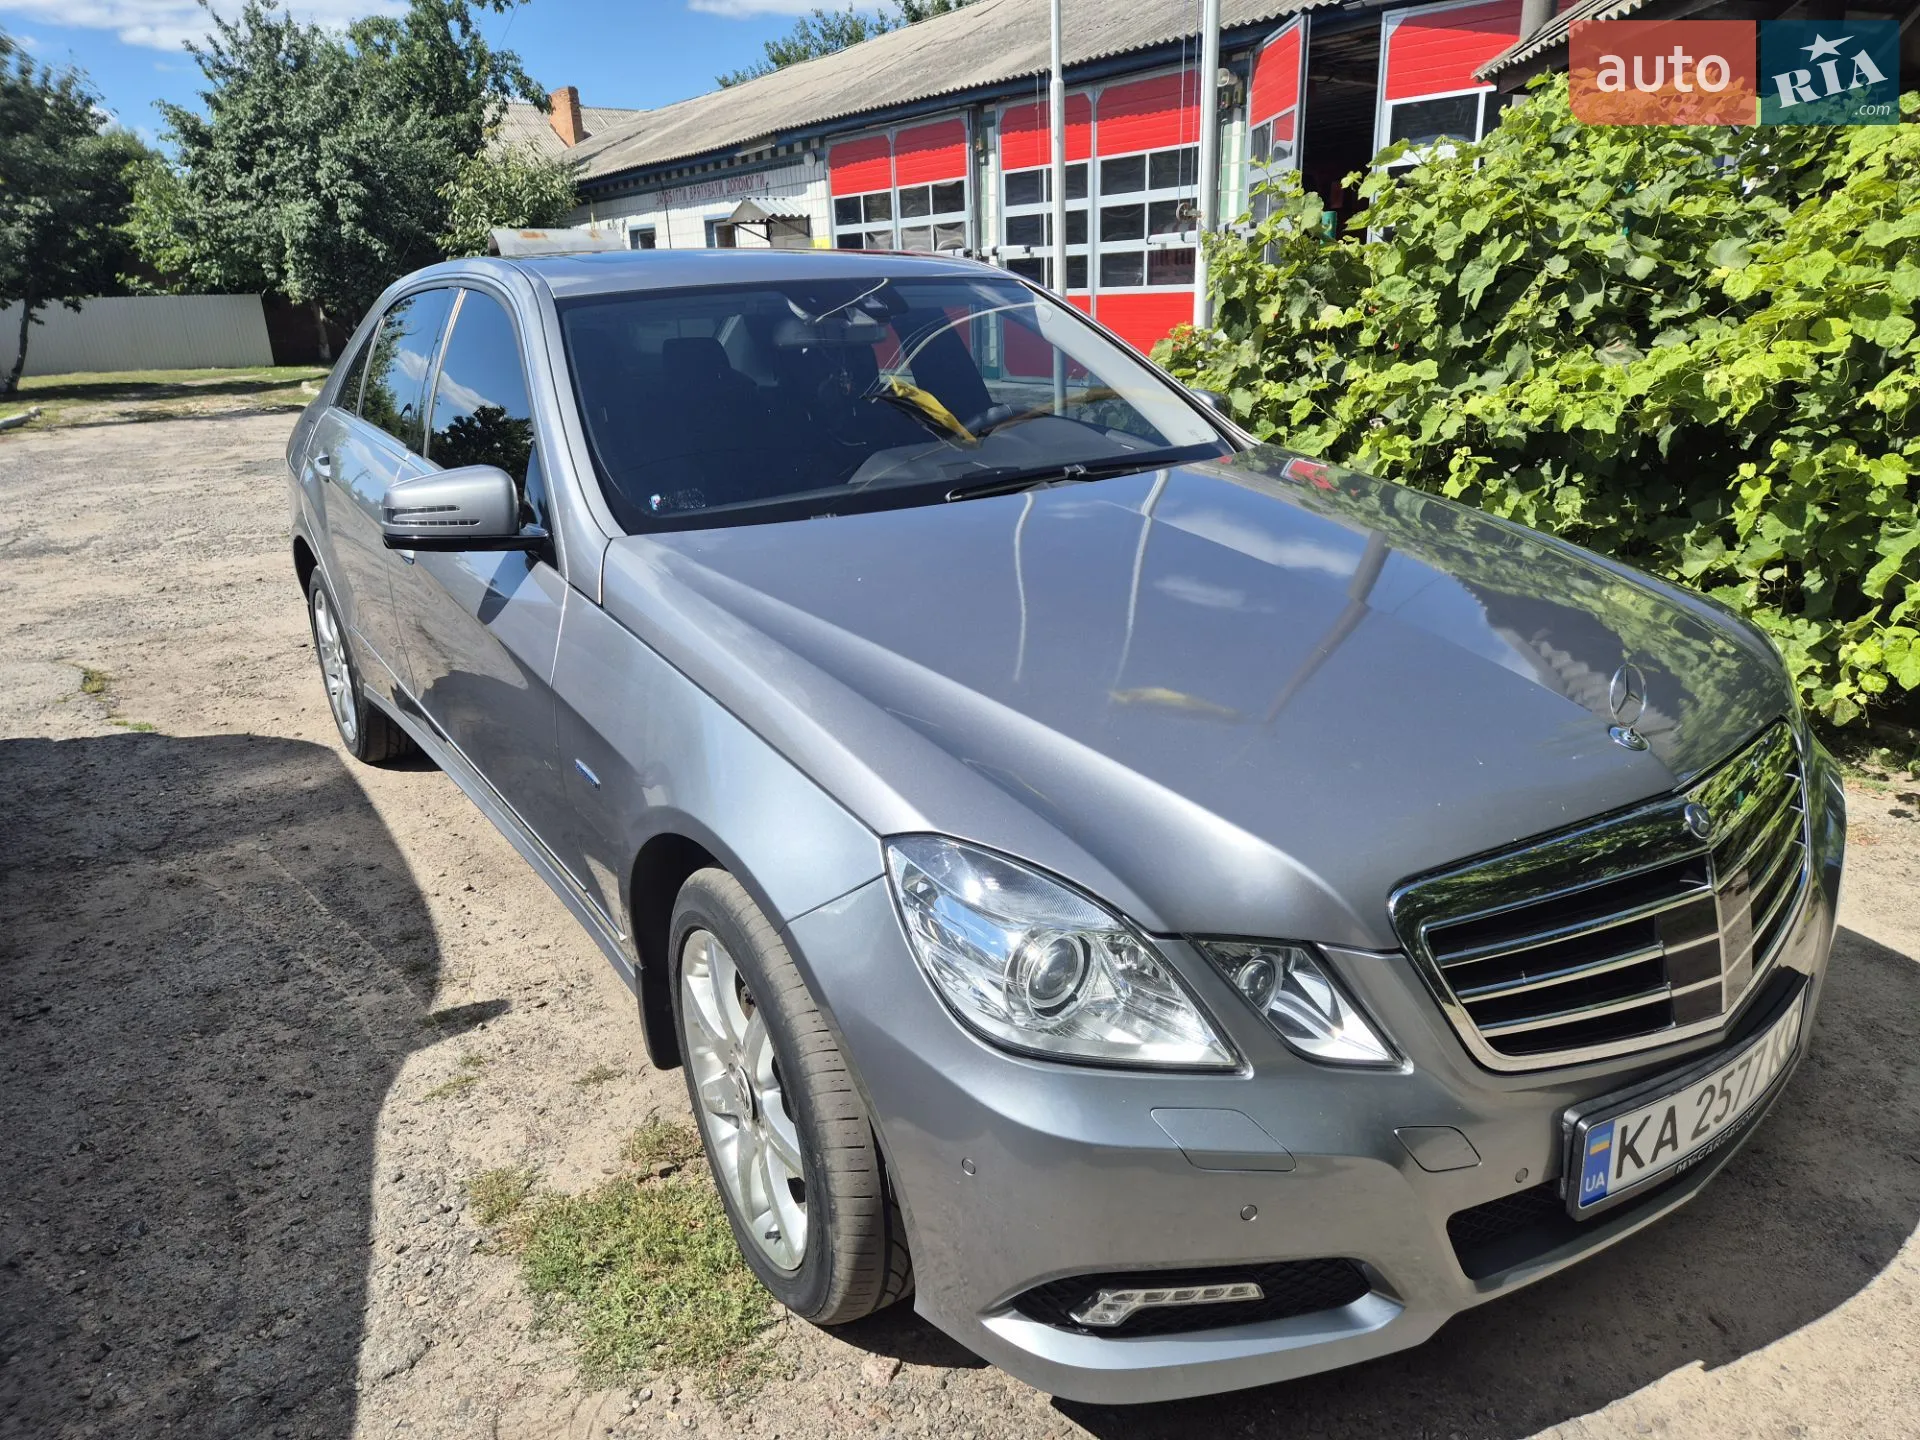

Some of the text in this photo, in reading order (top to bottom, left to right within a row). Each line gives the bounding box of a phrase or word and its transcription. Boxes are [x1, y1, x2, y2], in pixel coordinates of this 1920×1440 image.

[1615, 1104, 1679, 1179] KA
[1690, 1039, 1769, 1141] 2577
[1585, 1171, 1605, 1193] UA
